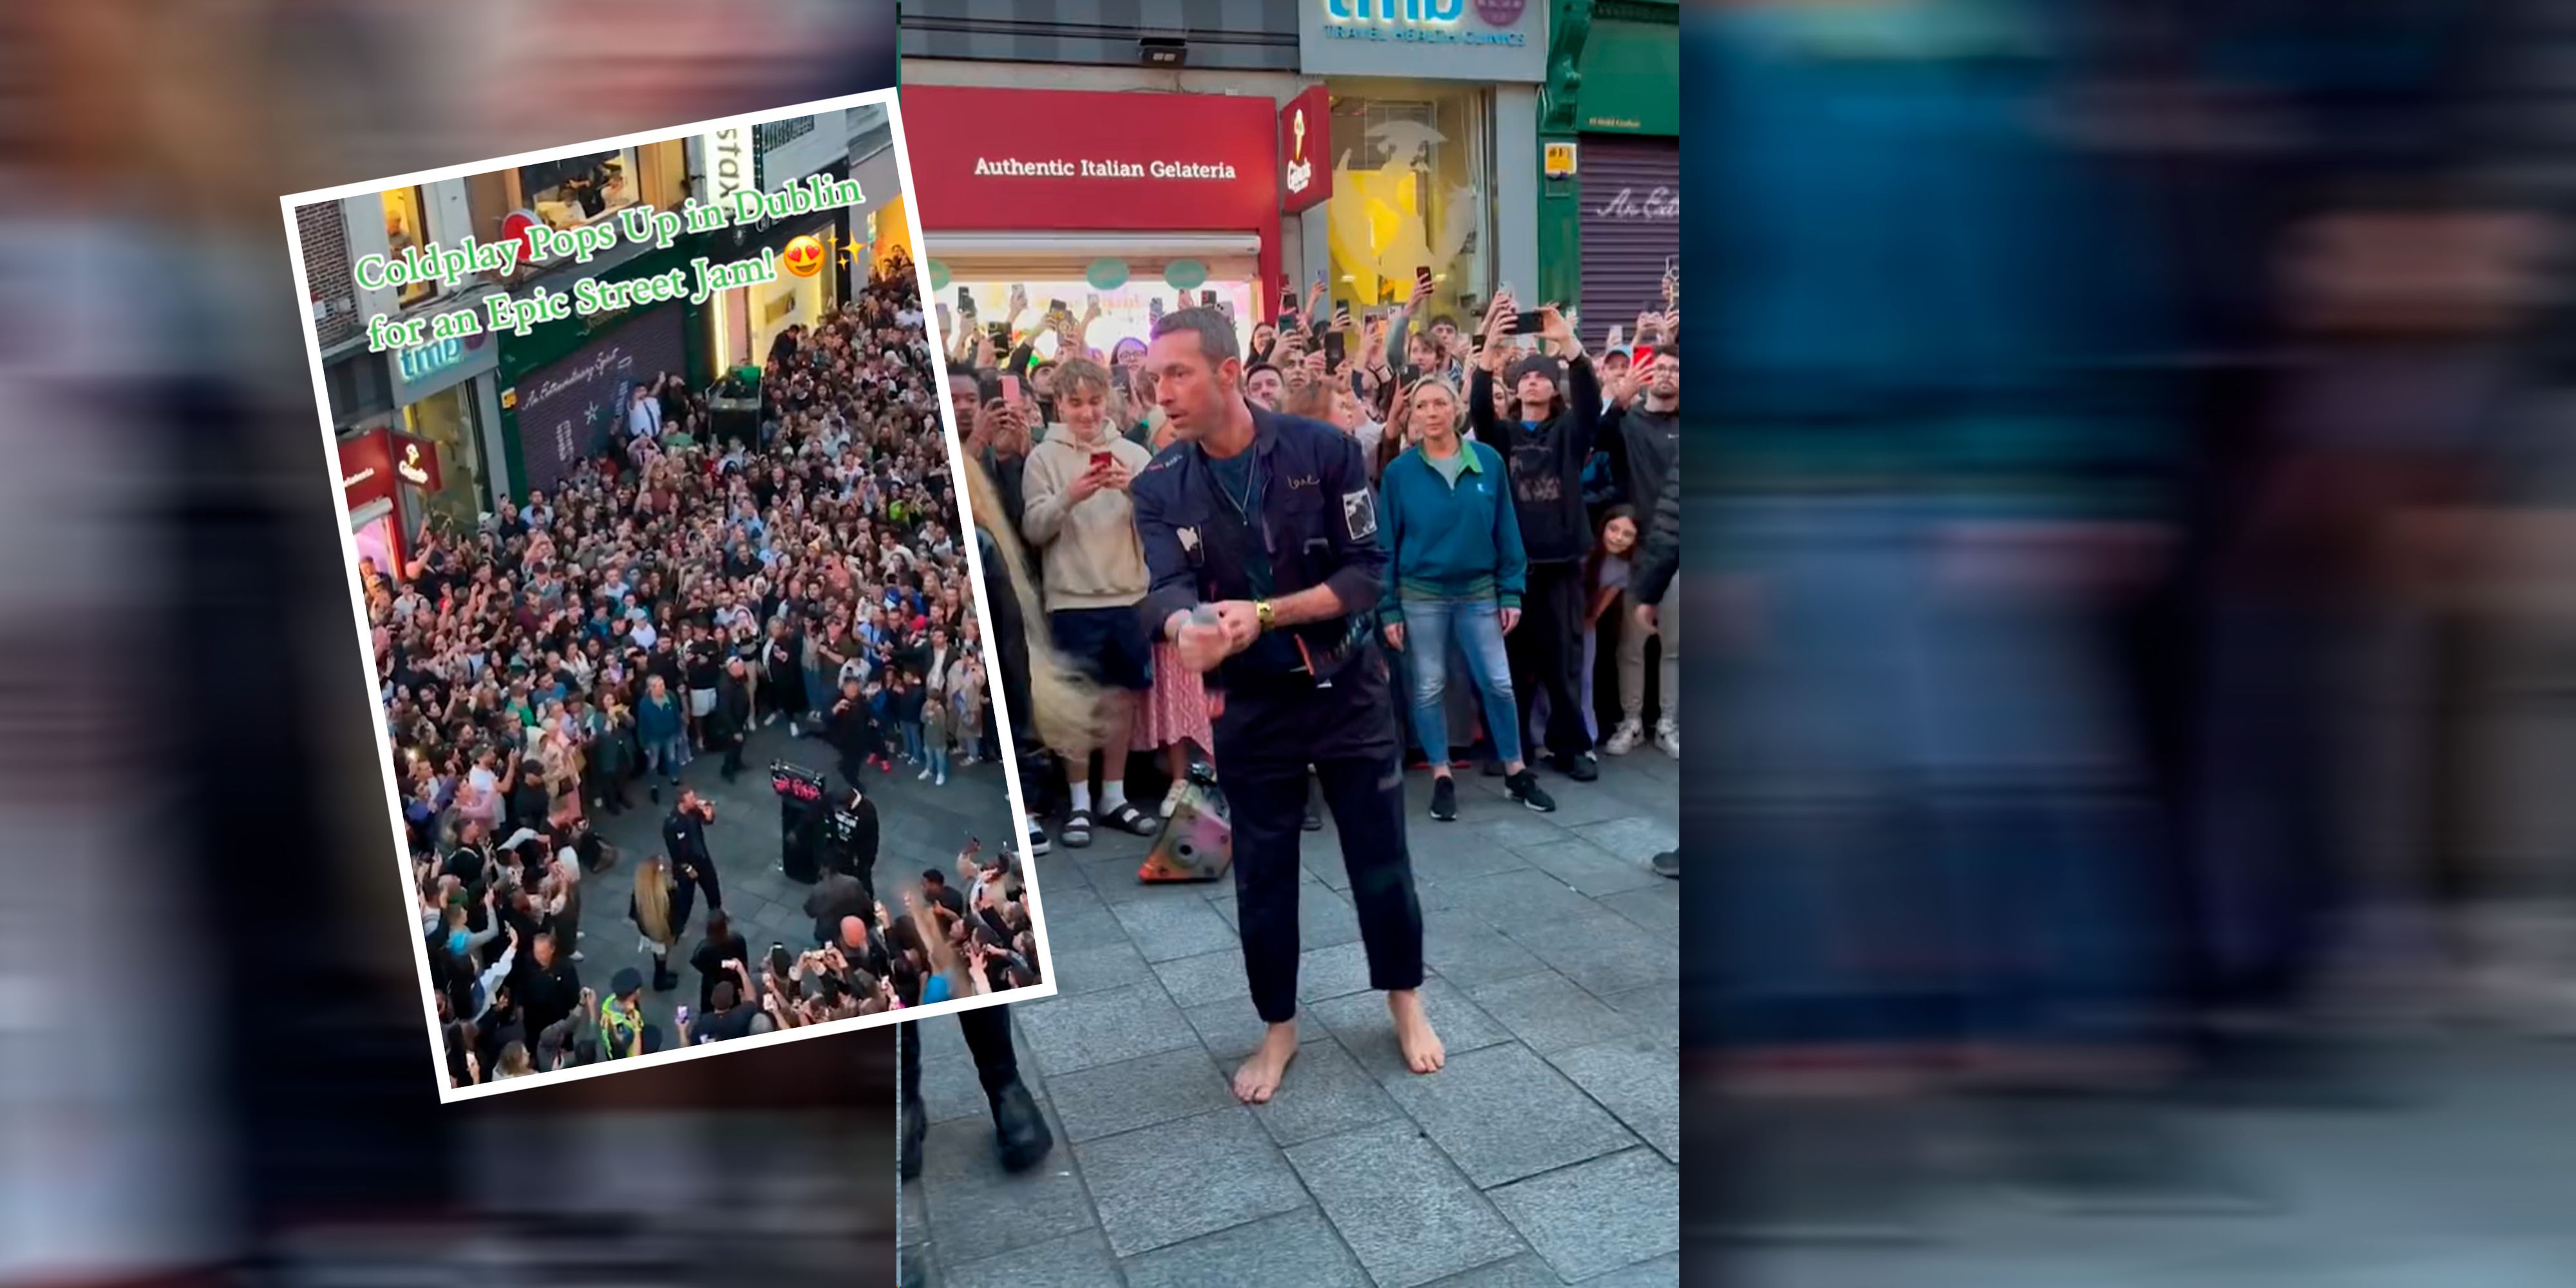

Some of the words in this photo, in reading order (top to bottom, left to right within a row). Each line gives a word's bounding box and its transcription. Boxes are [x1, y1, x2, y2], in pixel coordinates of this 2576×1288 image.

[974, 157, 1074, 176] Authentic
[1081, 159, 1144, 178] Italian
[1150, 160, 1236, 179] Gelateria
